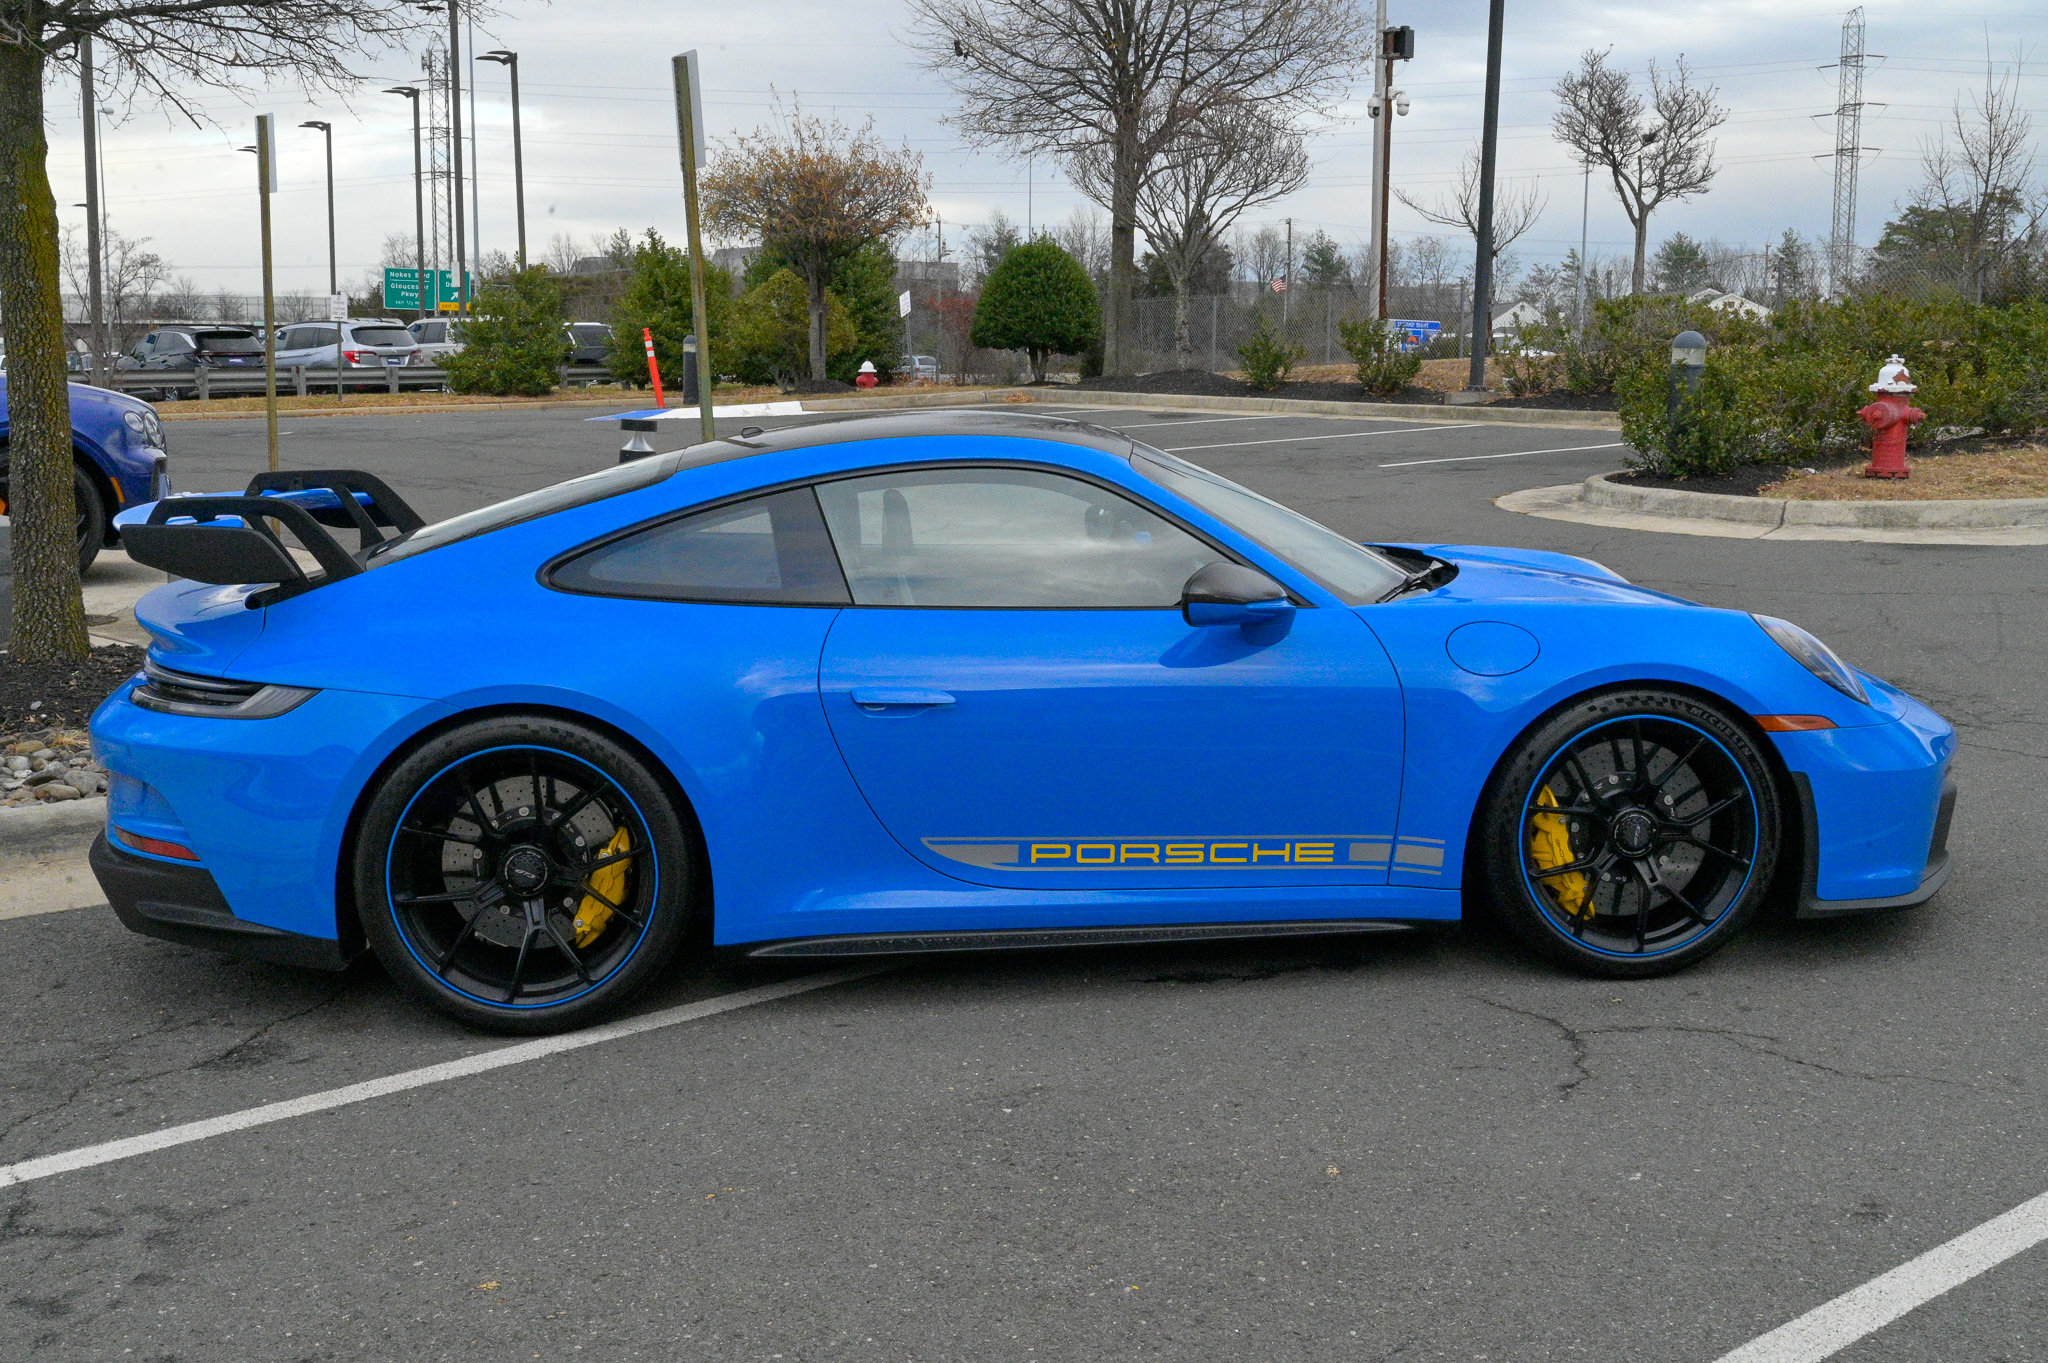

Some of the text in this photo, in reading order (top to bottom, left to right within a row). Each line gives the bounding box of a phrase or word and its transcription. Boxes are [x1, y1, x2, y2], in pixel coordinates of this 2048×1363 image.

[389, 271, 412, 279] Nokes
[401, 291, 419, 299] Pkwy
[1690, 706, 1752, 756] MICHELIN
[1030, 842, 1335, 864] PORSCHE
